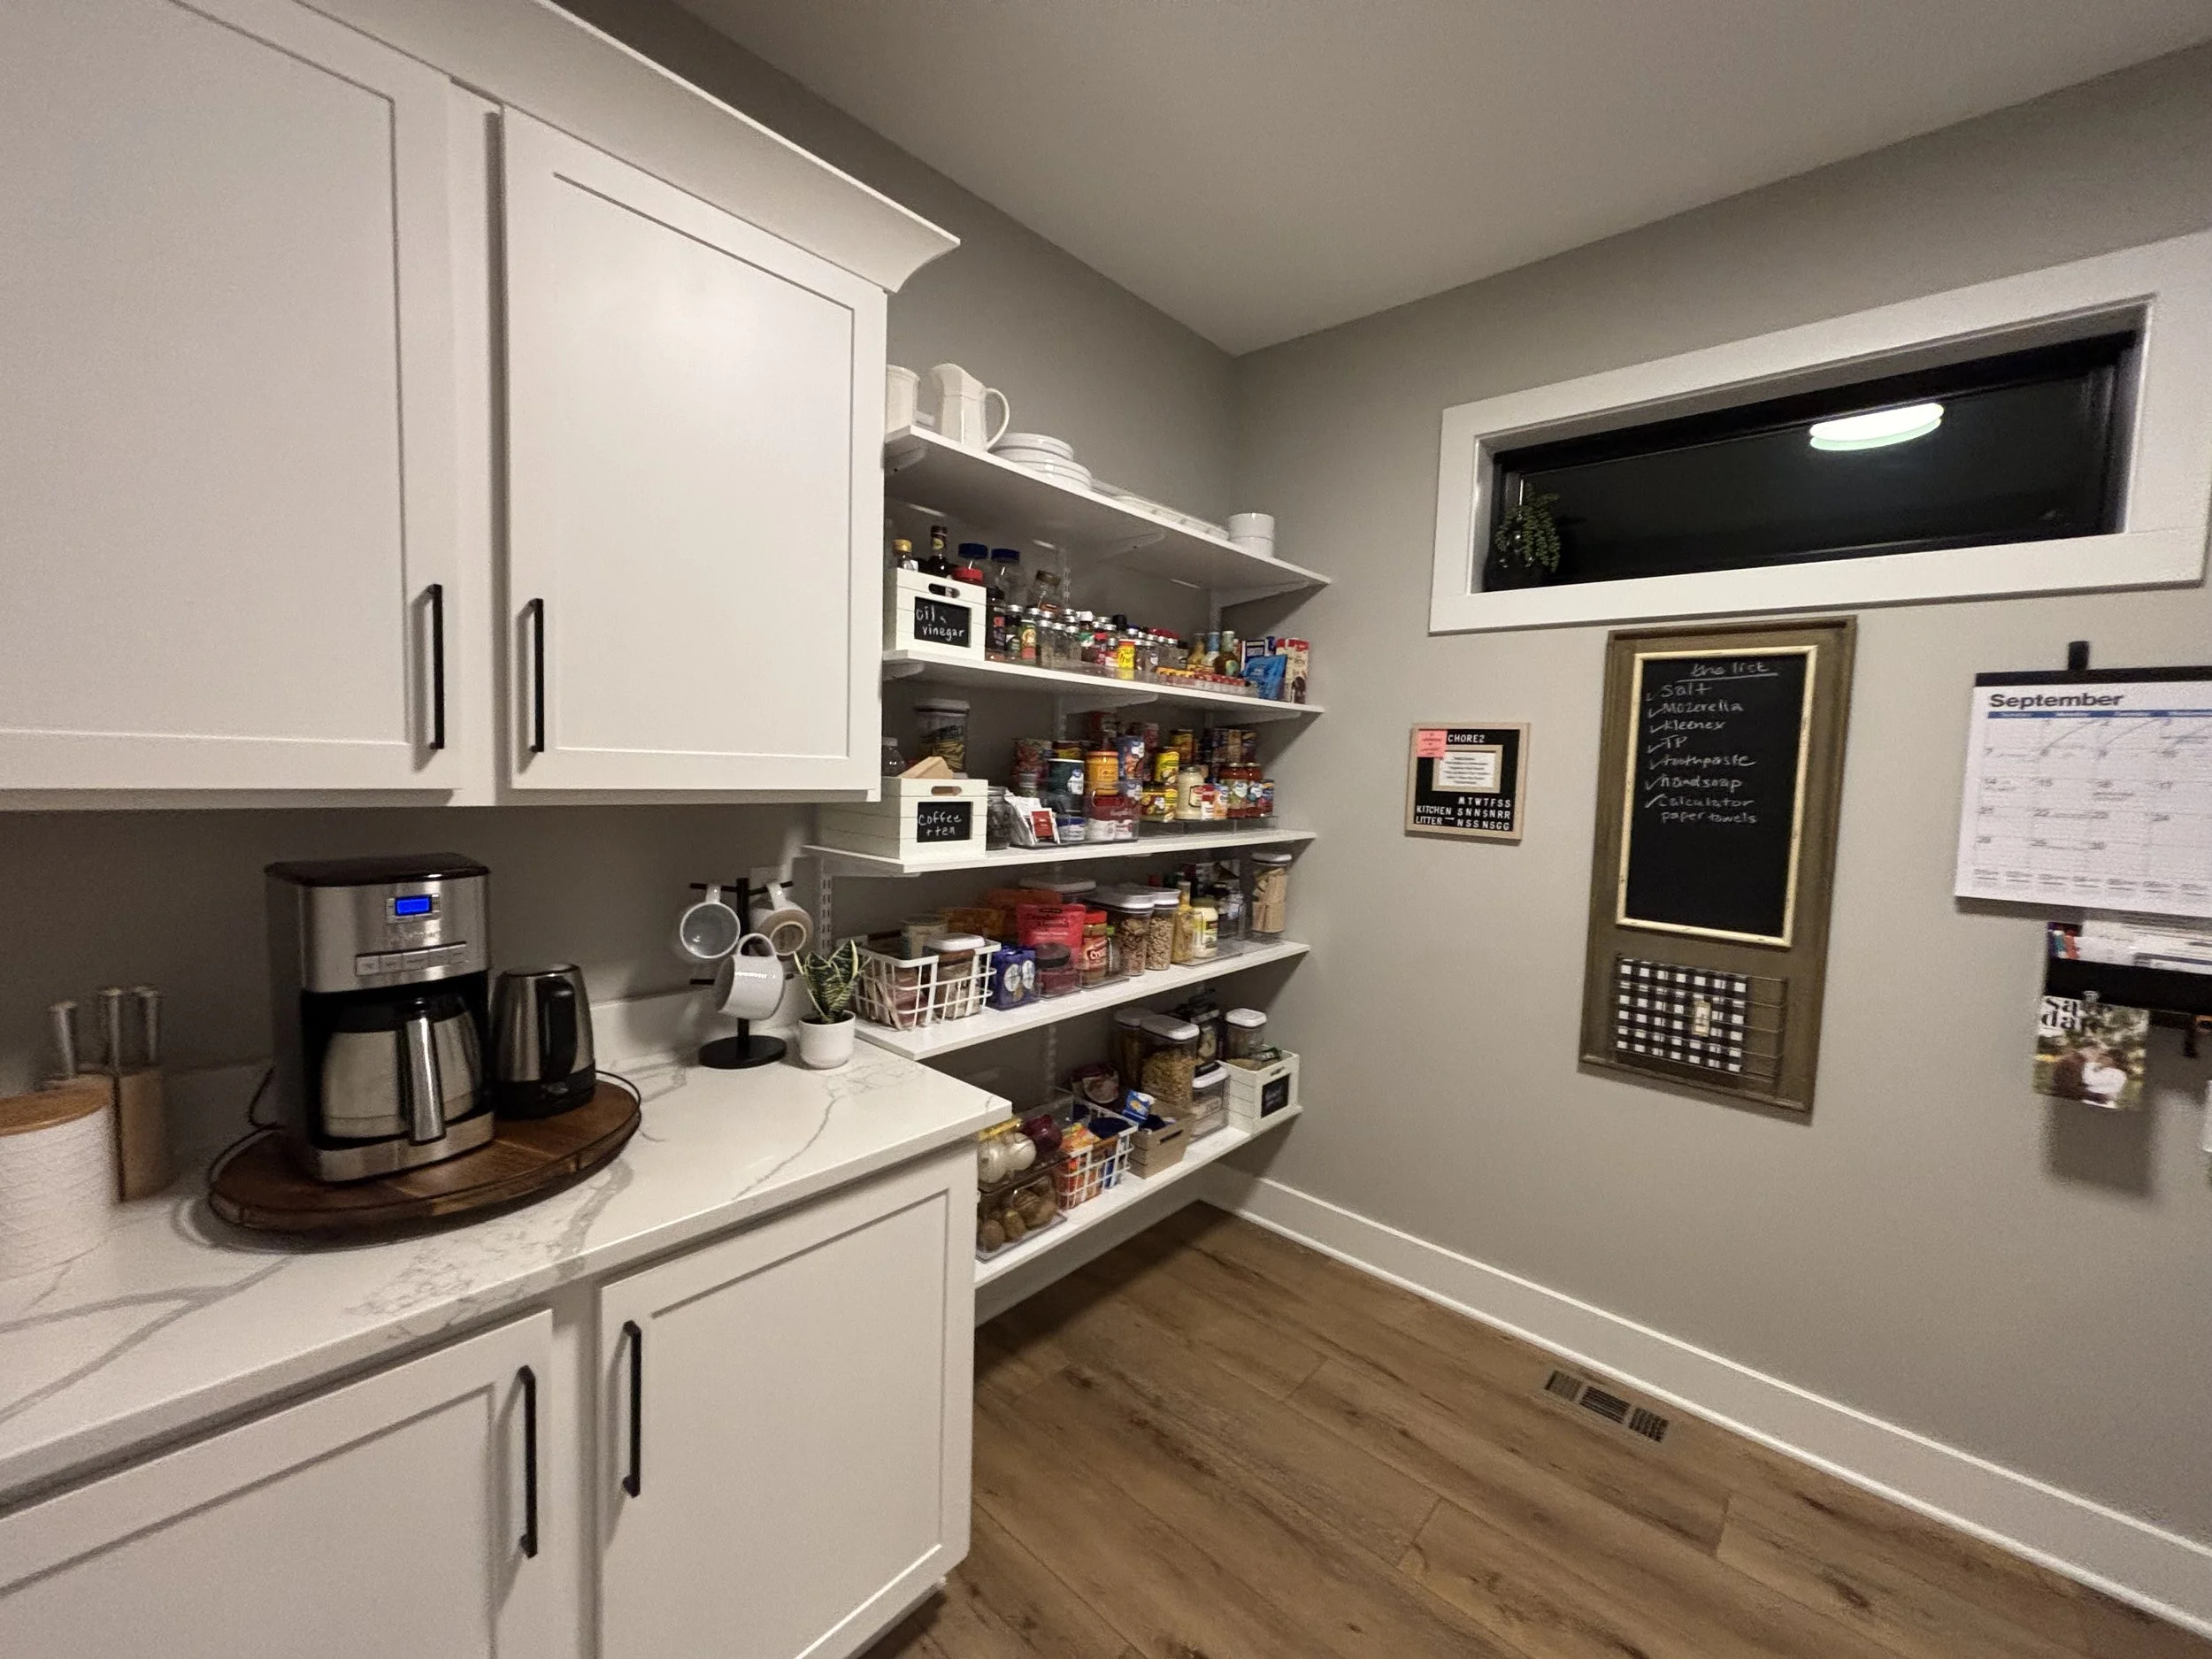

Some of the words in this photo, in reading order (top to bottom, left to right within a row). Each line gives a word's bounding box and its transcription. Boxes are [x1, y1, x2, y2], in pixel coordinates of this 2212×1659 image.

[922, 624, 965, 642] vinegar
[1690, 663, 1724, 677] the
[1732, 661, 1770, 674] list
[1661, 682, 1711, 698] Salt
[1990, 693, 2124, 710] September
[1660, 734, 1687, 749] TP
[1417, 805, 1452, 815] KITCHEN
[1661, 811, 1704, 823] paper
[1708, 811, 1758, 823] towels
[1416, 816, 1443, 826] LITTER
